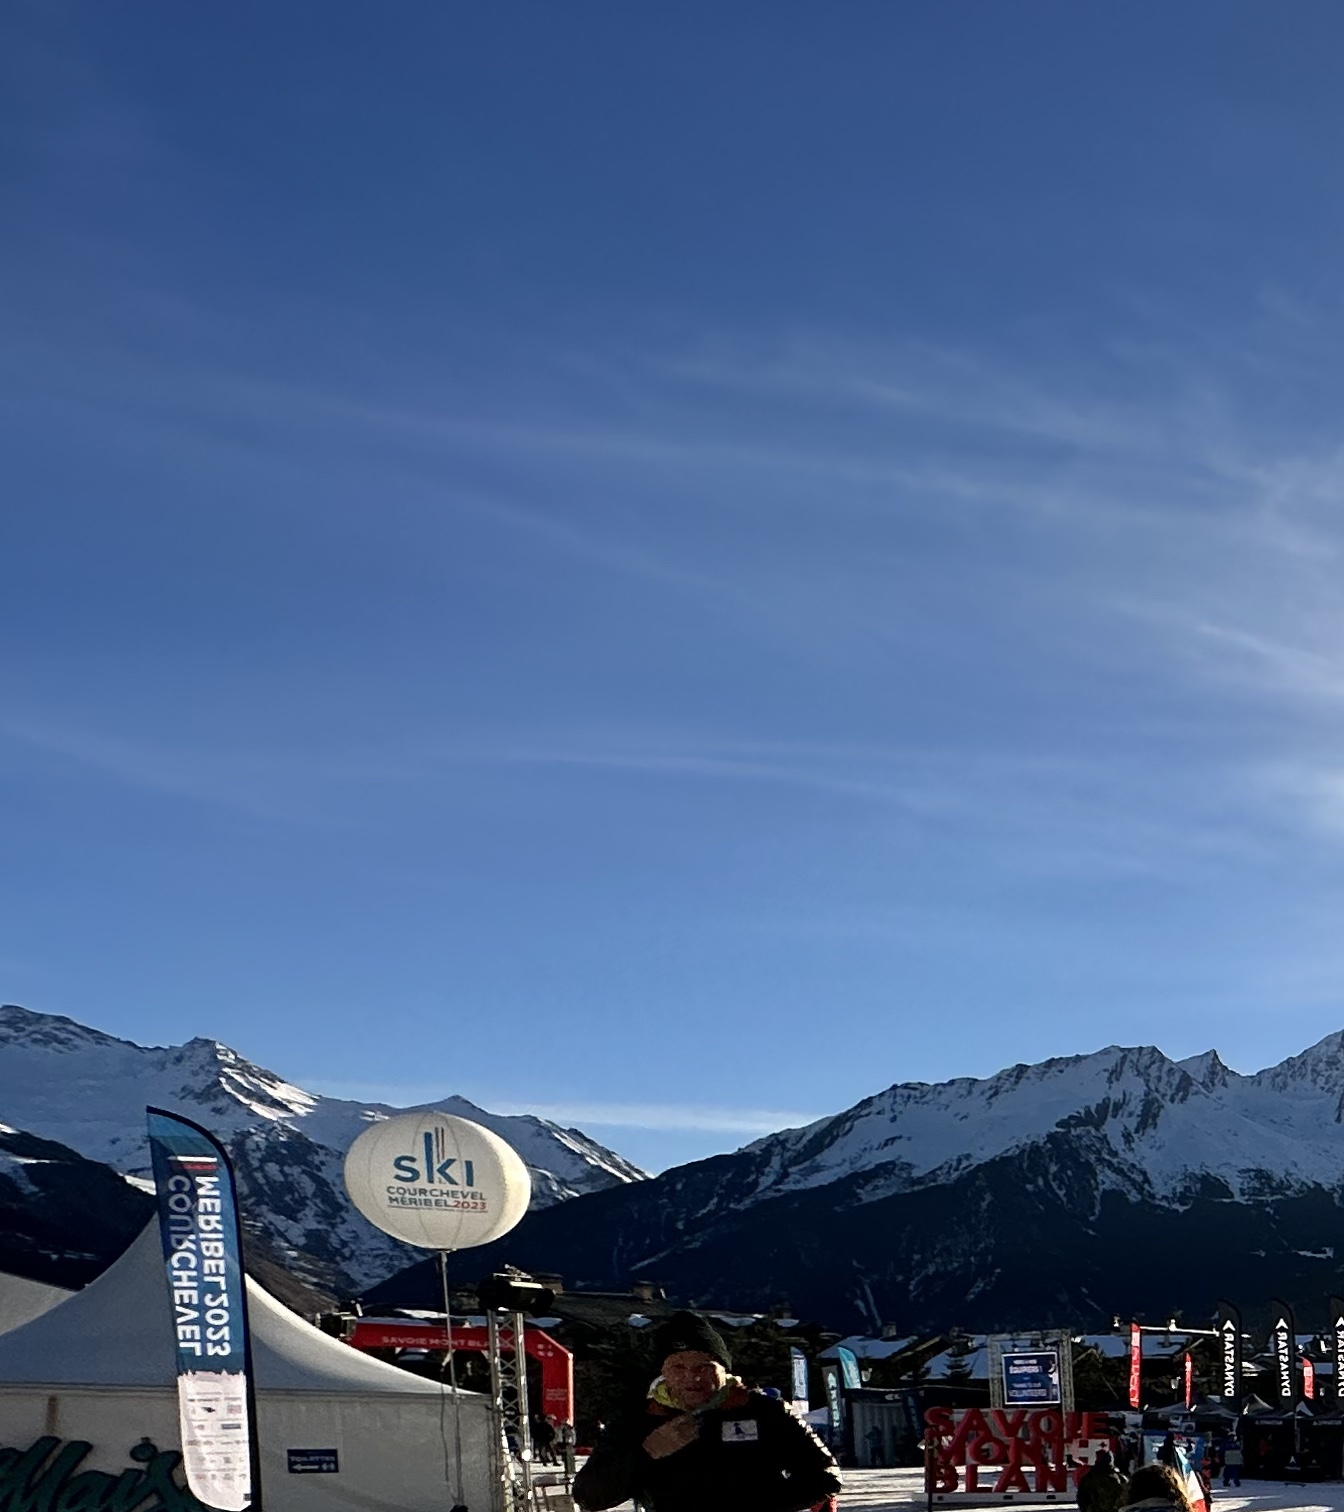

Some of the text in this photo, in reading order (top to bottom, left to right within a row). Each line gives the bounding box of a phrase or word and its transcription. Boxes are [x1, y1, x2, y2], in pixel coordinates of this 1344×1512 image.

[386, 1185, 487, 1201] COURCHEVEL
[382, 1336, 427, 1346] SAVOIE
[924, 1406, 1110, 1446] SAVOIE
